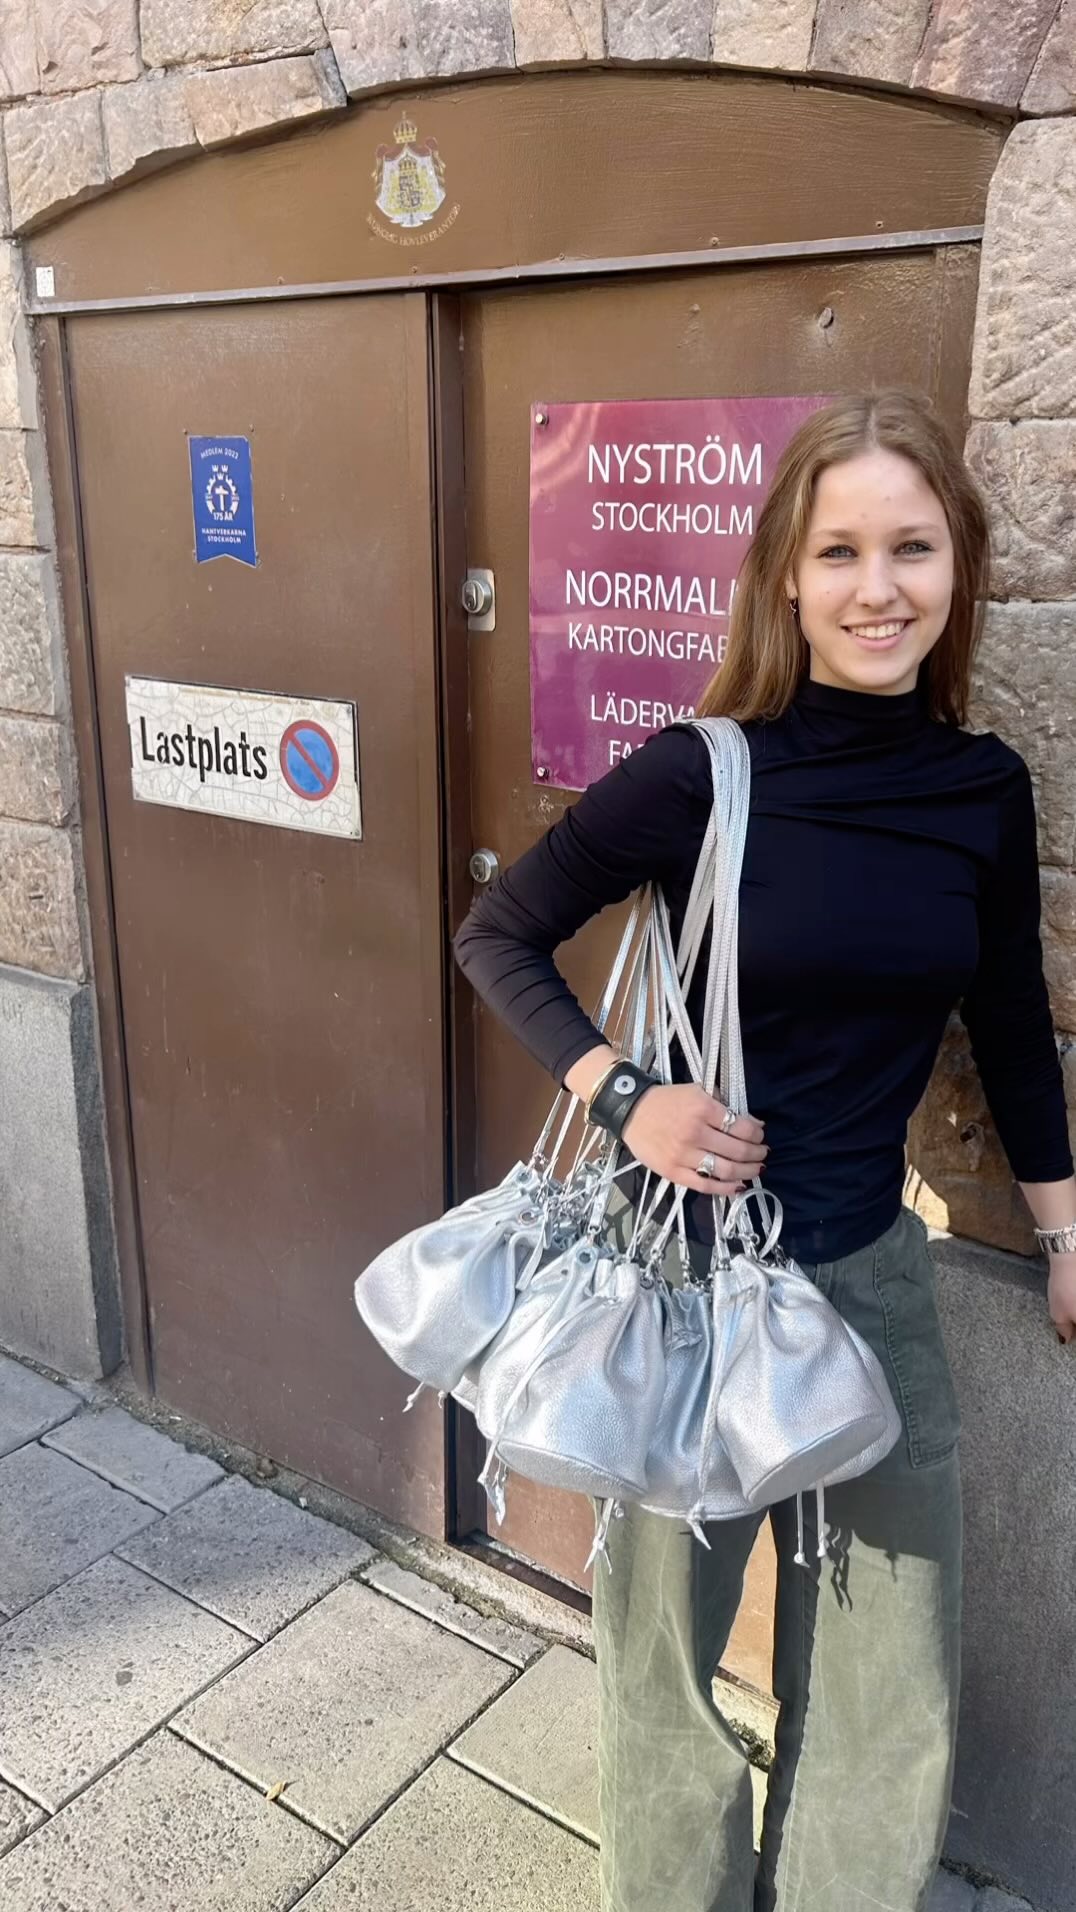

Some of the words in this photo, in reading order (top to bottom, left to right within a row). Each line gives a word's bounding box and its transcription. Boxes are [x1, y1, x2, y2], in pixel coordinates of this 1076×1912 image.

[200, 447, 223, 459] MEDLEM
[588, 435, 762, 485] NYSTRÖM
[213, 511, 224, 521] 175
[592, 501, 753, 536] STOCKHOLM
[201, 527, 246, 537] HANTVERKARNA
[207, 536, 241, 544] STOCKHOLM
[140, 716, 268, 783] Lastplats
